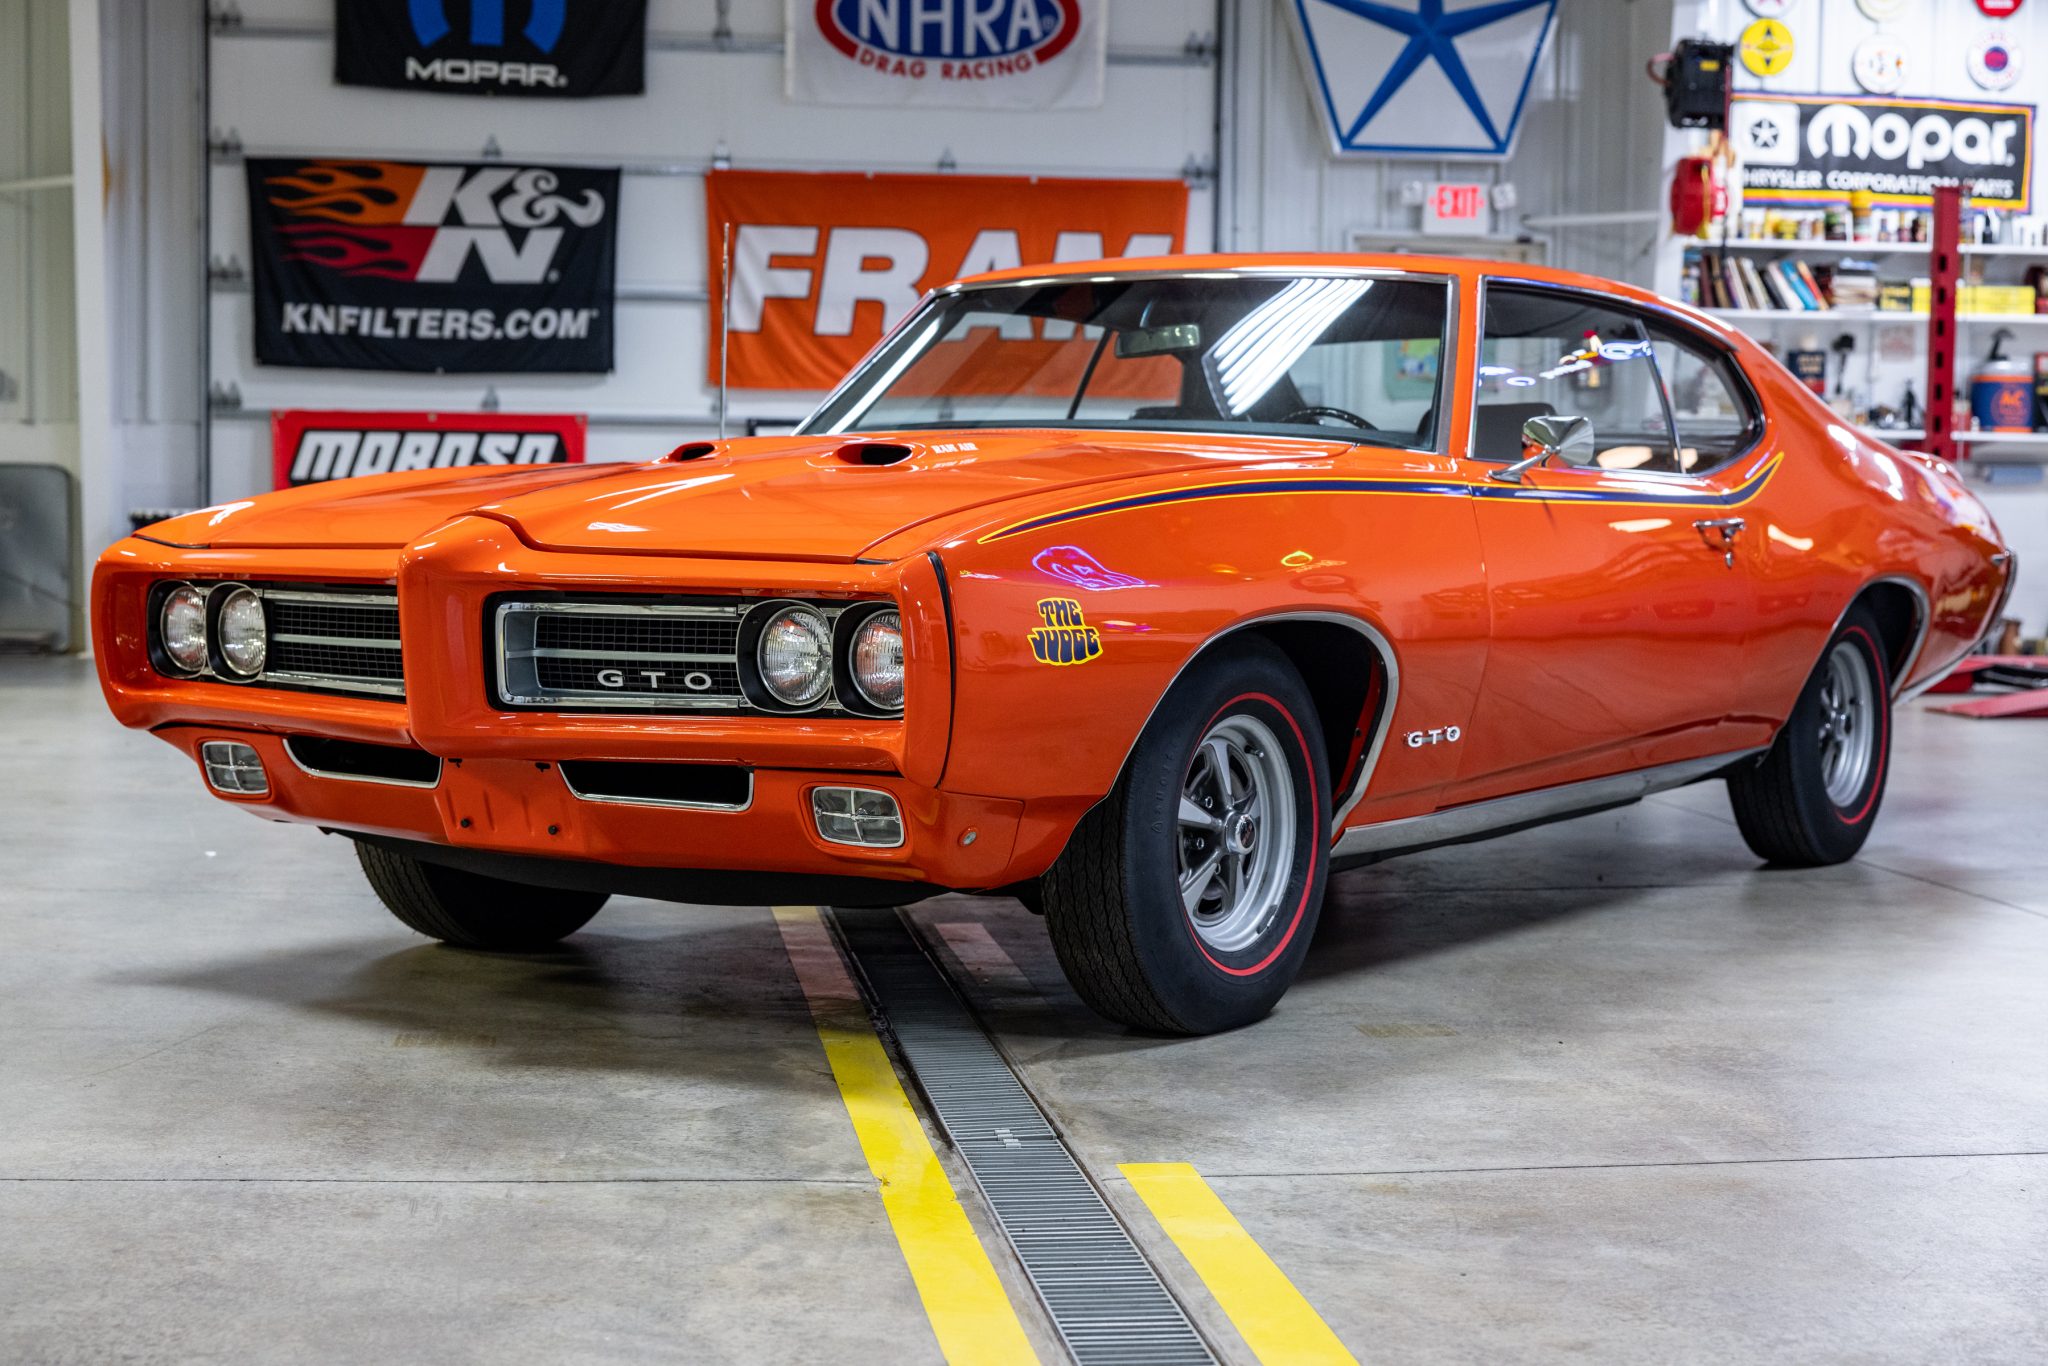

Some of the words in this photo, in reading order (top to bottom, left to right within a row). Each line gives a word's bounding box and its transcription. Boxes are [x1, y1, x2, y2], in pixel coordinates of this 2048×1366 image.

[857, 0, 1043, 56] NHRA
[858, 48, 927, 79] DRAG
[940, 52, 1033, 81] RACING
[1743, 167, 1823, 189] HRYSLER
[1437, 184, 1480, 219] EXIT
[281, 302, 592, 340] KNFILTERS.COM
[931, 443, 958, 454] RAM
[957, 442, 979, 451] AIR
[1038, 599, 1083, 627] THE
[1029, 628, 1101, 663] JUDGE
[597, 669, 712, 690] GTO
[1407, 725, 1461, 748] GTO
